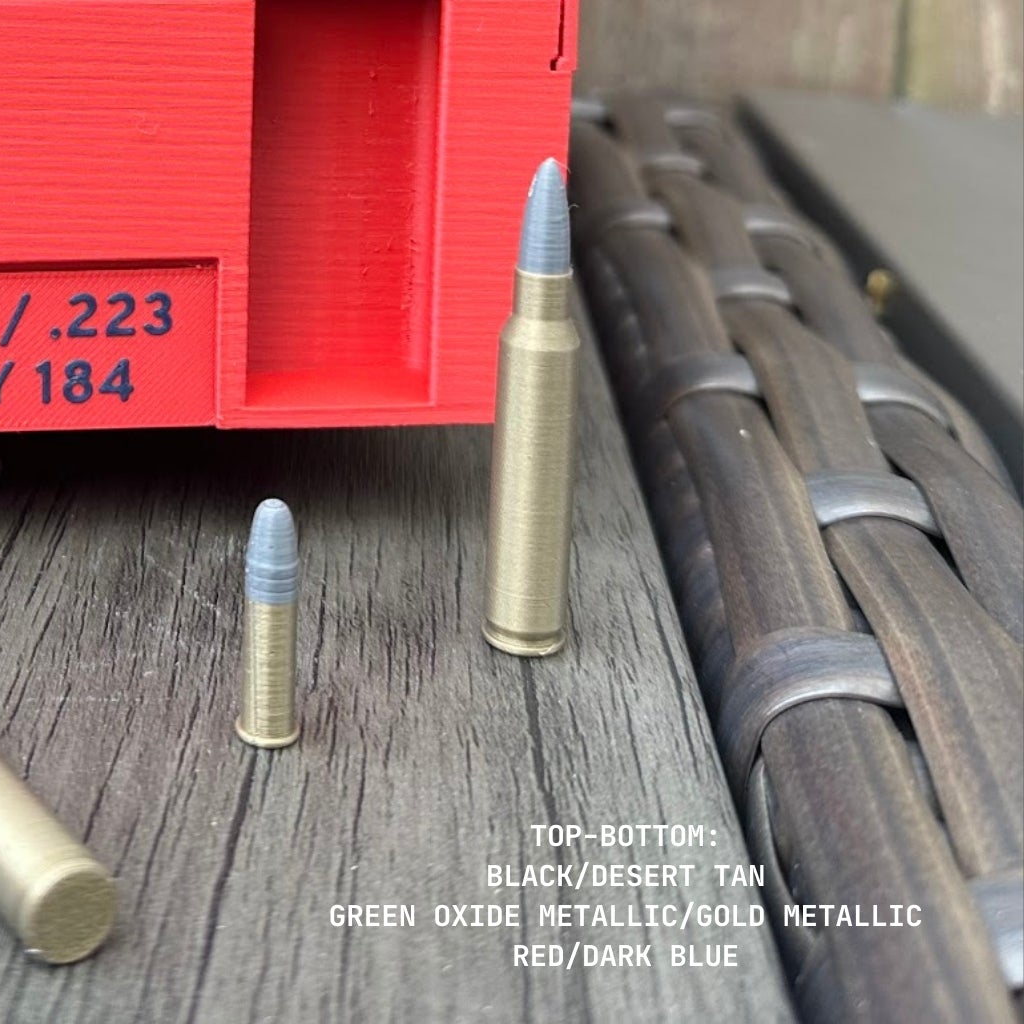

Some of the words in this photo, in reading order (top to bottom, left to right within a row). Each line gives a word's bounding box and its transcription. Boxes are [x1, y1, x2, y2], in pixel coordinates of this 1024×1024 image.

[0, 293, 31, 347] /
[49, 291, 174, 340] .223
[35, 358, 135, 405] 184
